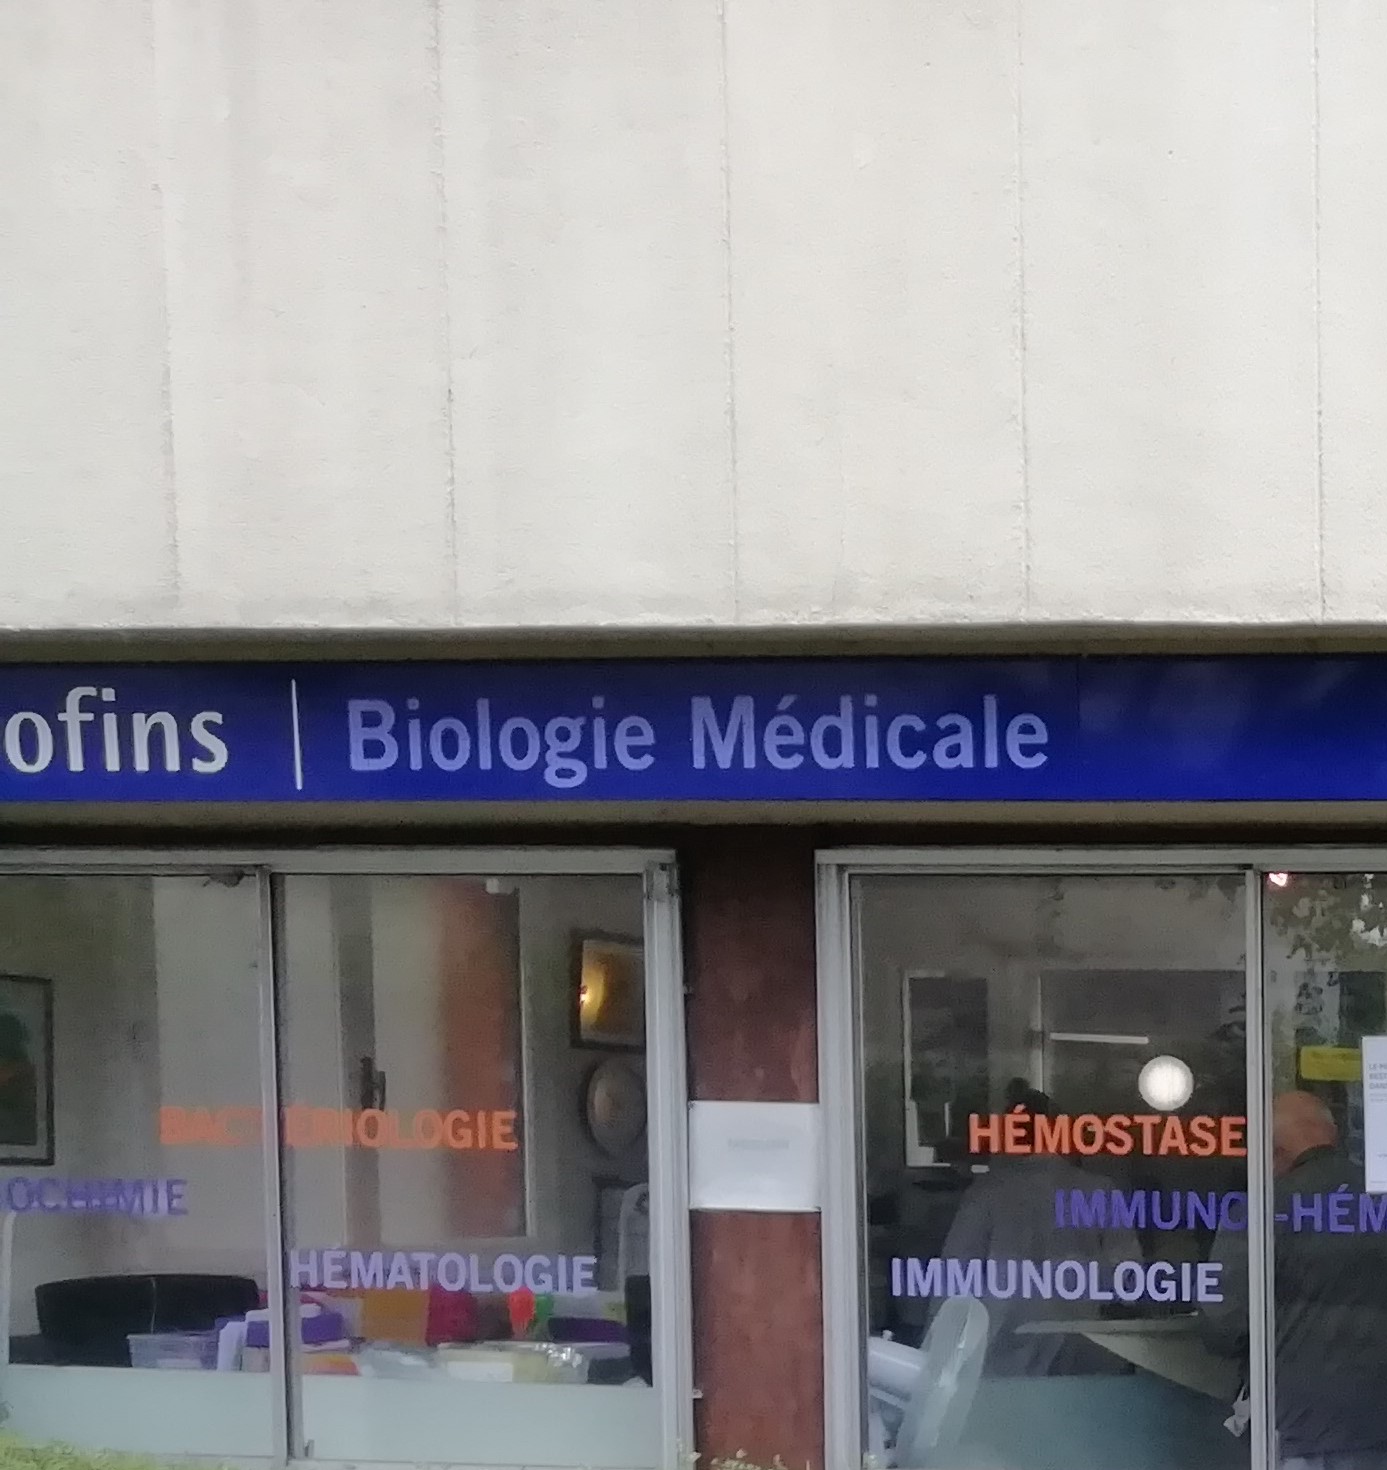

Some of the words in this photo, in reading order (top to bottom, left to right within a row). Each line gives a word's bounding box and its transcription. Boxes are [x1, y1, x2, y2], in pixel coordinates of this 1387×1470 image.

[4, 686, 228, 773] ofins
[348, 698, 655, 788] Biologie
[691, 694, 1049, 769] Médicale
[968, 1104, 1248, 1156] HÉMOSTASE
[891, 1257, 1224, 1302] IMMUNOLOGIE
